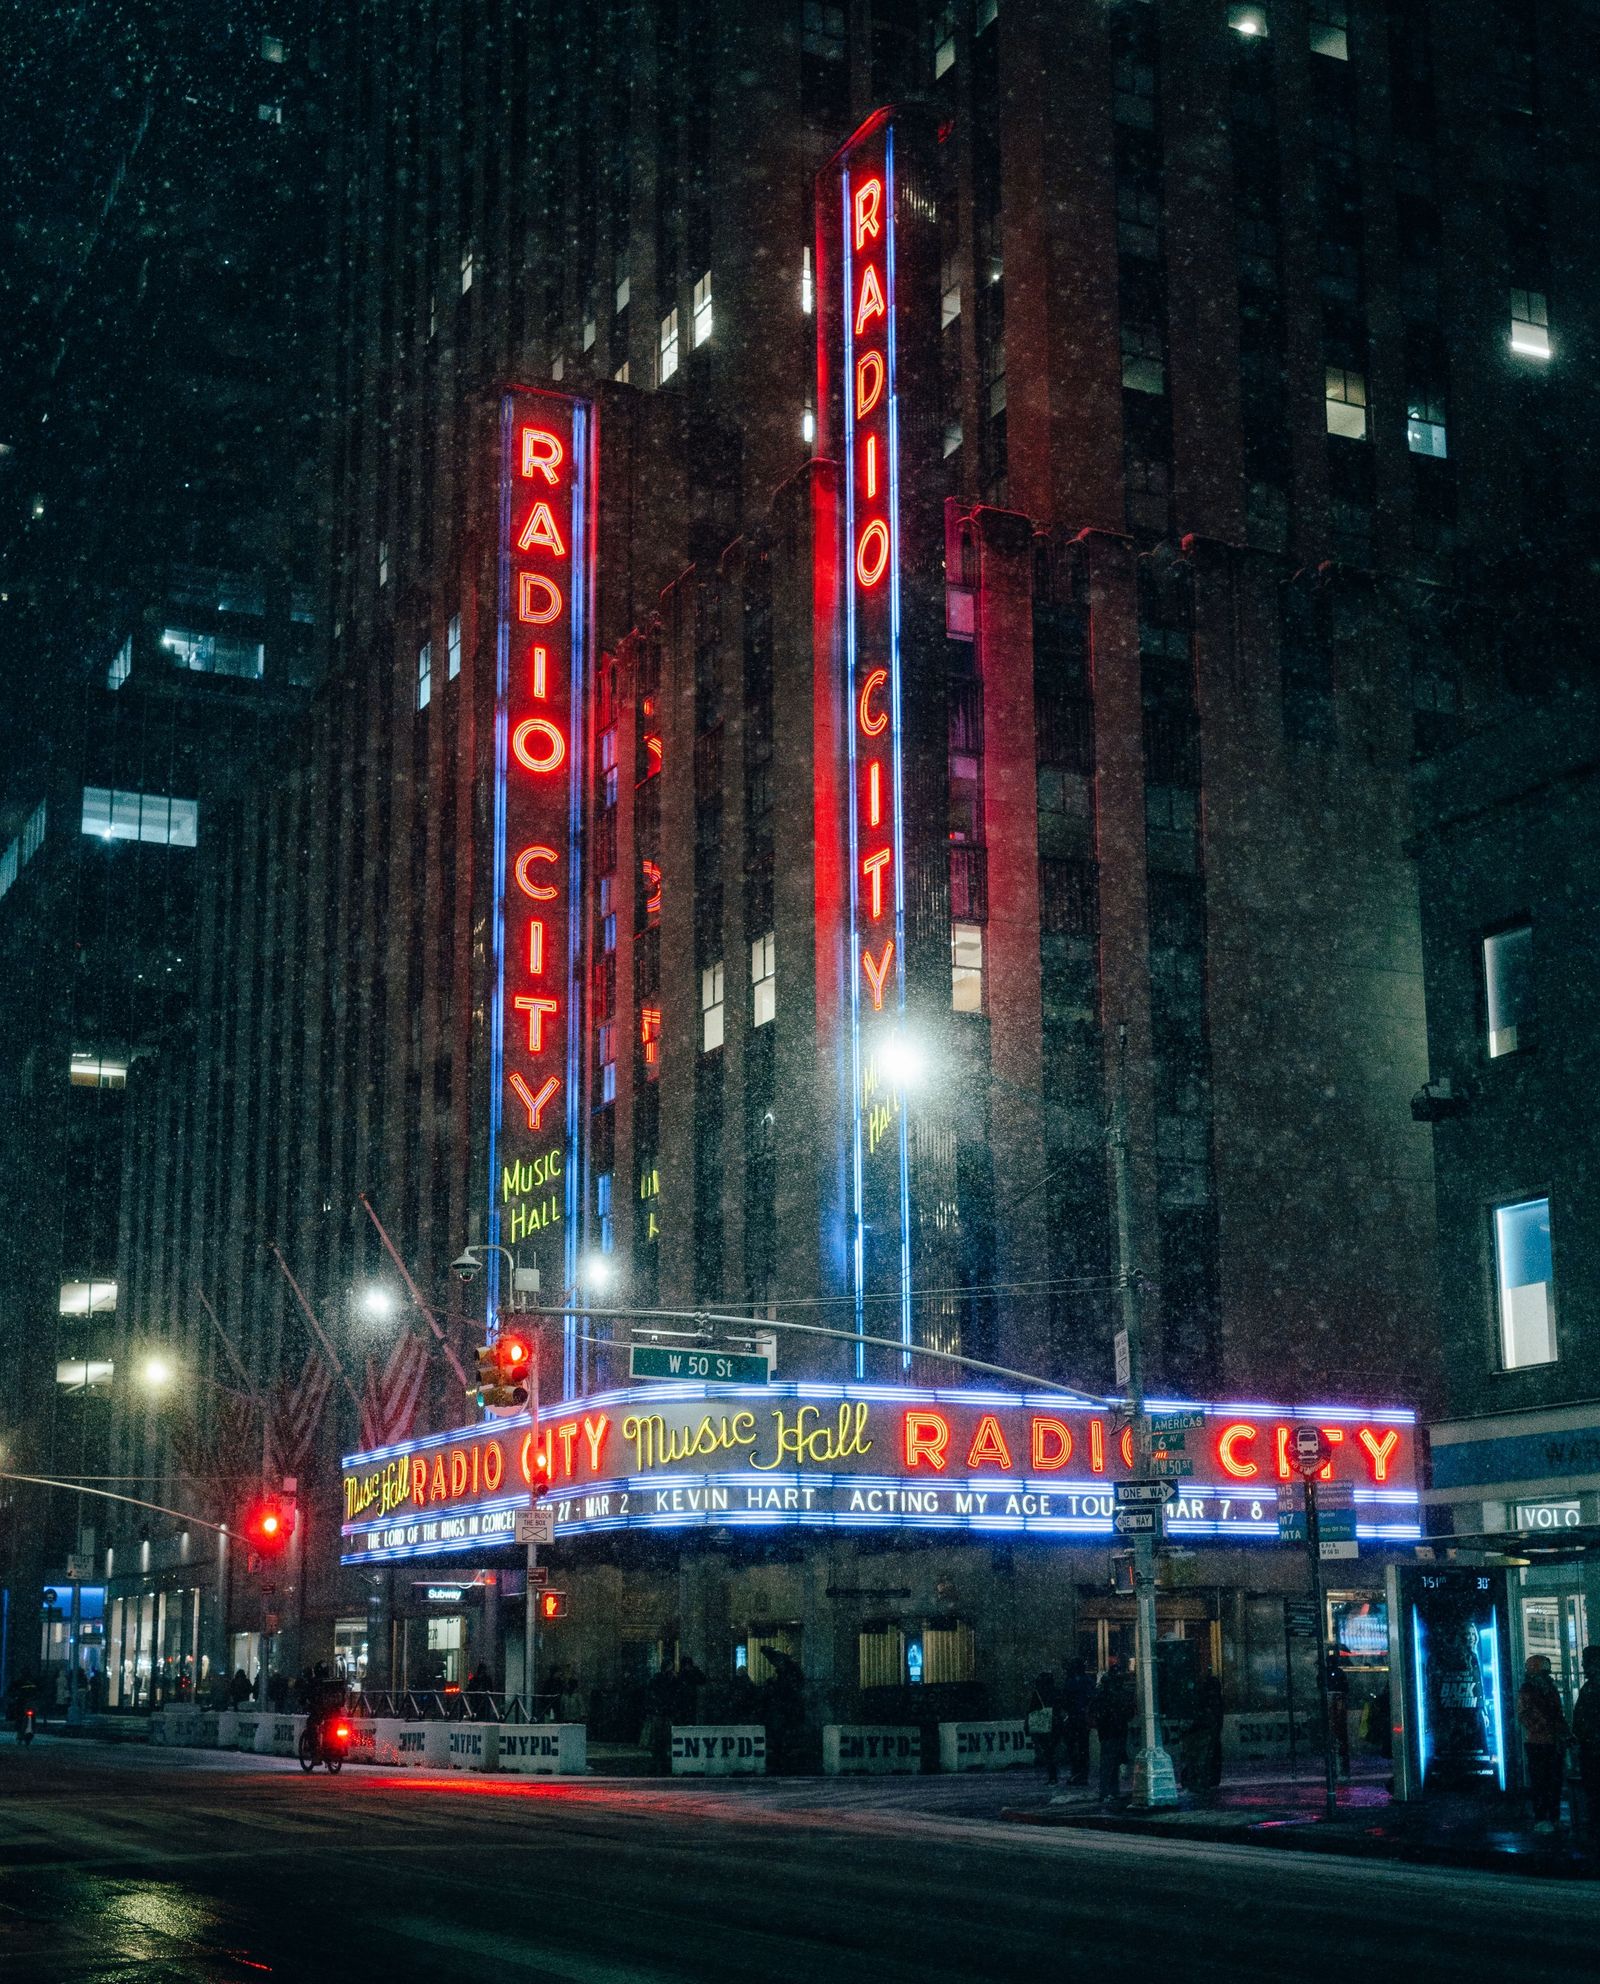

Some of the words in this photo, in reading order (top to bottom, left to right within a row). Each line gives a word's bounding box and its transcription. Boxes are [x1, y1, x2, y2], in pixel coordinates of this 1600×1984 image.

[856, 178, 889, 586] RADIO
[512, 427, 565, 773] RADIO
[860, 668, 895, 1010] CITY
[509, 845, 561, 1130] CITY
[502, 1149, 562, 1203] MUSIC
[509, 1195, 561, 1244] HALL
[669, 1355, 682, 1373] W
[688, 1357, 709, 1376] 50
[716, 1359, 734, 1377] St
[1155, 1416, 1203, 1431] AMERICAS
[1158, 1437, 1167, 1451] 6
[344, 1474, 379, 1519] Music
[376, 1454, 411, 1518] Hall
[412, 1441, 502, 1506] RADIO
[623, 1410, 757, 1471] Music
[749, 1402, 874, 1470] Hall
[904, 1411, 1134, 1474] RADI
[1169, 1460, 1181, 1475] 50
[656, 1489, 729, 1513] KEVIN
[747, 1488, 816, 1510] HART
[1123, 1488, 1142, 1498] ONE
[1150, 1486, 1169, 1497] WAY
[1278, 1484, 1293, 1496] M5
[558, 1501, 572, 1522] 27
[585, 1494, 610, 1518] MAR
[620, 1494, 629, 1514] 2
[851, 1490, 940, 1513] ACTING
[955, 1493, 988, 1514] MY
[1005, 1493, 1051, 1516] AGE
[1070, 1493, 1126, 1517] TOU
[1250, 1500, 1263, 1520] 8
[1279, 1498, 1294, 1511] M5
[535, 1511, 552, 1519] BLOCK
[1118, 1516, 1131, 1527] ONE
[1136, 1515, 1150, 1526] WAY
[1279, 1513, 1295, 1525] M7
[1525, 1508, 1580, 1528] VOLO
[368, 1531, 381, 1550] THE
[384, 1529, 405, 1547] LORD
[407, 1526, 419, 1544] OF
[423, 1523, 437, 1541] THE
[441, 1518, 465, 1538] RINGS
[469, 1517, 479, 1534] IN
[482, 1510, 515, 1534] CONCE
[1281, 1529, 1301, 1540] MTA
[428, 1588, 462, 1600] Subway
[1440, 1682, 1477, 1698] BACK
[454, 1734, 477, 1755] NYPD
[506, 1736, 551, 1757] NYPD
[684, 1737, 752, 1758] NYPD
[852, 1735, 910, 1759] NYPD
[967, 1730, 1026, 1753] NYPD
